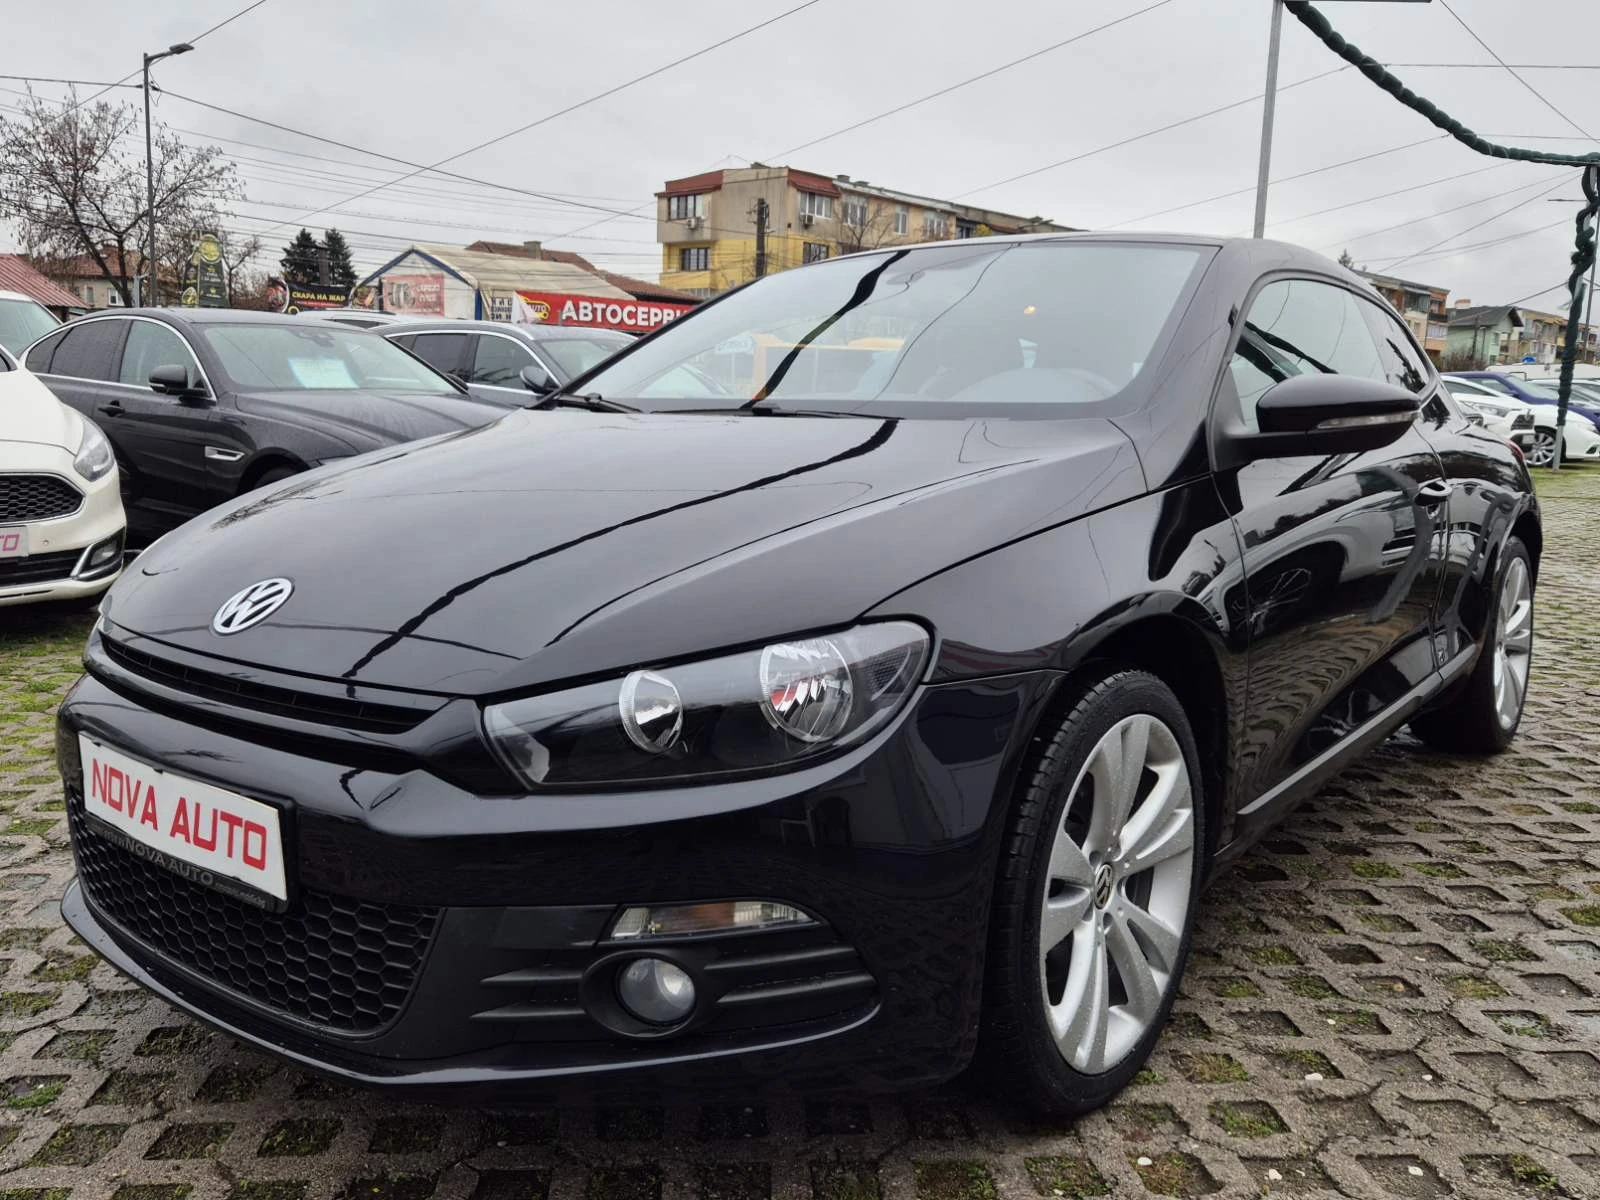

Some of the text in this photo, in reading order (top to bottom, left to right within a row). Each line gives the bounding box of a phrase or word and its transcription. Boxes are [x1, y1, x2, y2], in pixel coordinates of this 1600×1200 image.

[317, 293, 328, 301] НА
[329, 294, 346, 302] ЖАР
[92, 758, 268, 872] NOVA AUTO
[124, 839, 214, 886] NOVA AUTO
